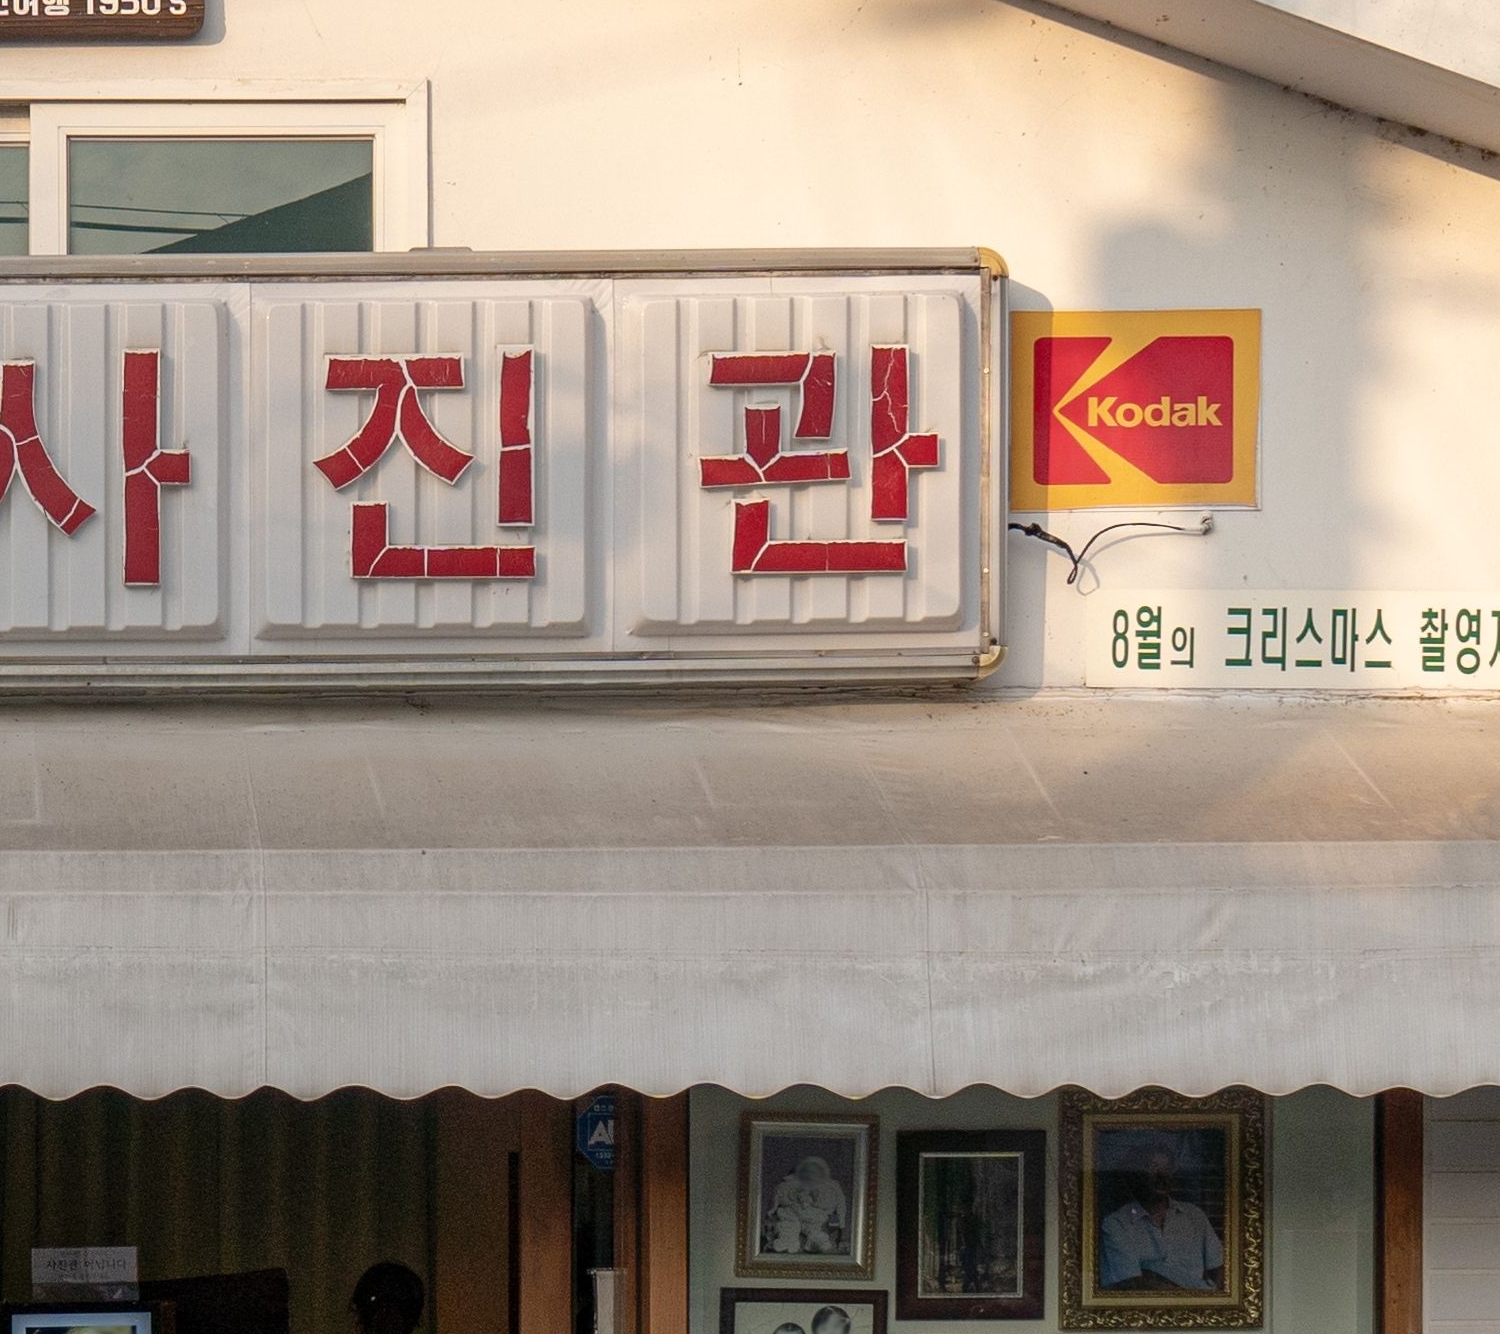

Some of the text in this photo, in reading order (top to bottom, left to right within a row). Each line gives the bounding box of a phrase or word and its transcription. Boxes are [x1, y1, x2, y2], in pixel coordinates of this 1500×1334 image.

[1084, 397, 1223, 432] Kodak
[1109, 605, 1197, 674] 8월의
[1224, 605, 1394, 674] 크리스마스
